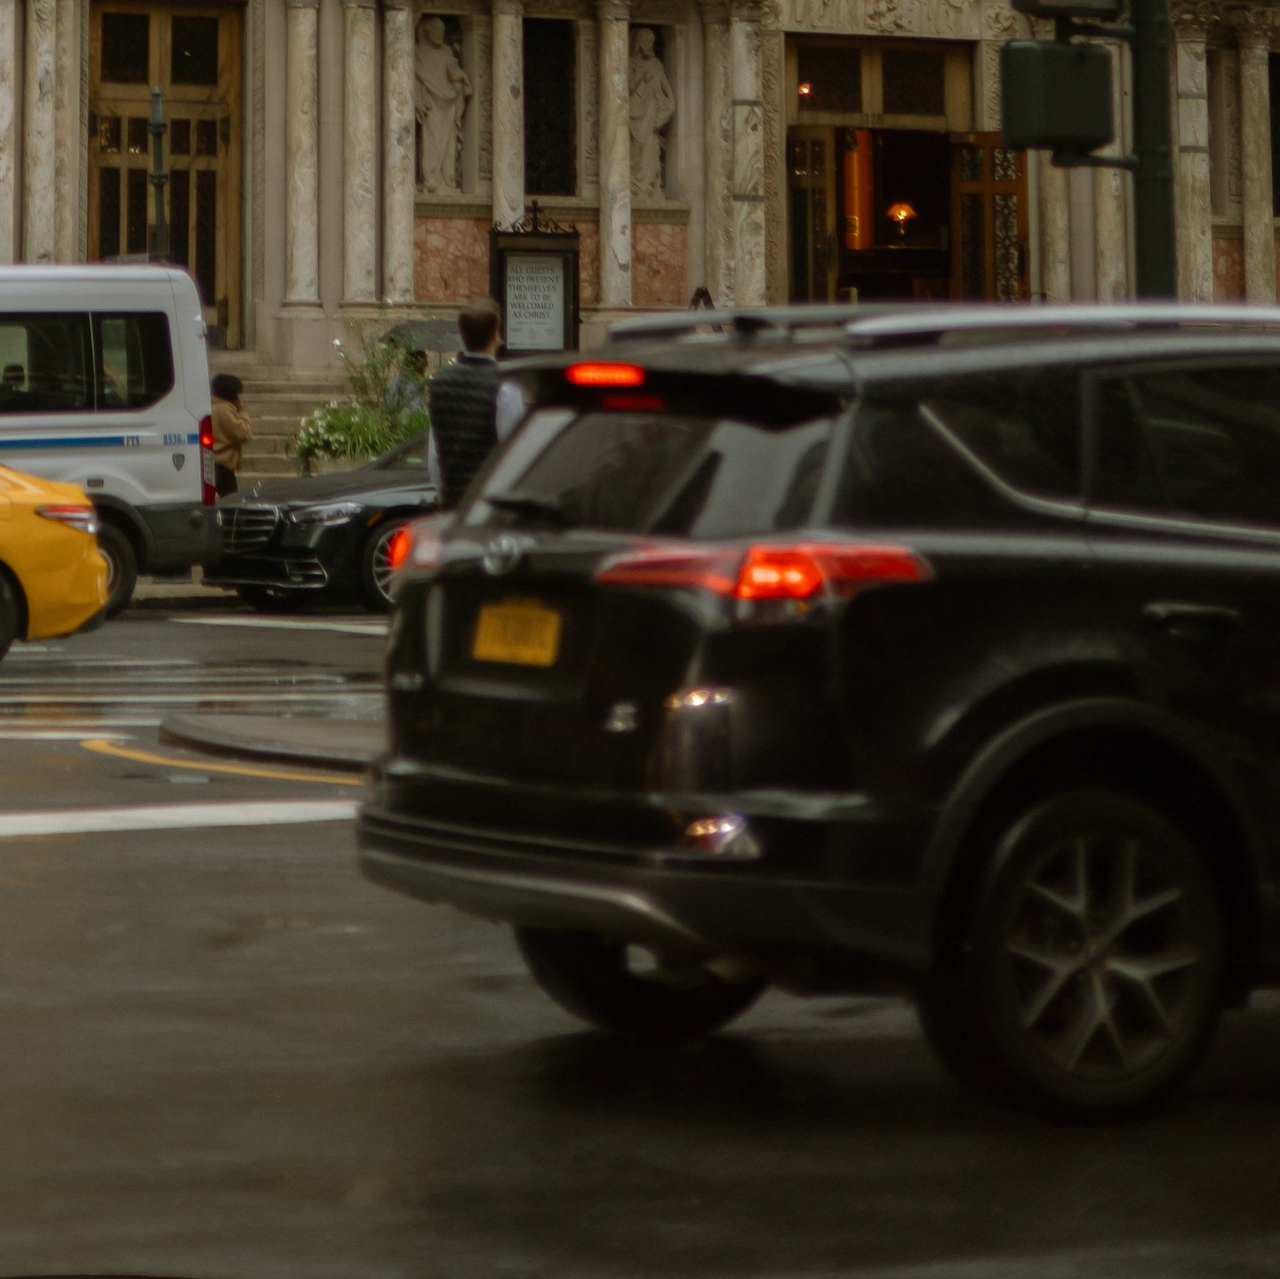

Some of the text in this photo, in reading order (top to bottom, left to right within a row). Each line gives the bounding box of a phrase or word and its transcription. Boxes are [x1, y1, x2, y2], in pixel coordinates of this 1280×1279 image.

[511, 266, 523, 275] ALL
[526, 275, 559, 283] PRESENT
[508, 284, 557, 292] THEMSELVES
[514, 293, 526, 301] ARE
[530, 293, 540, 301] TO
[510, 302, 555, 310] WELCOMED
[513, 311, 522, 319] AS
